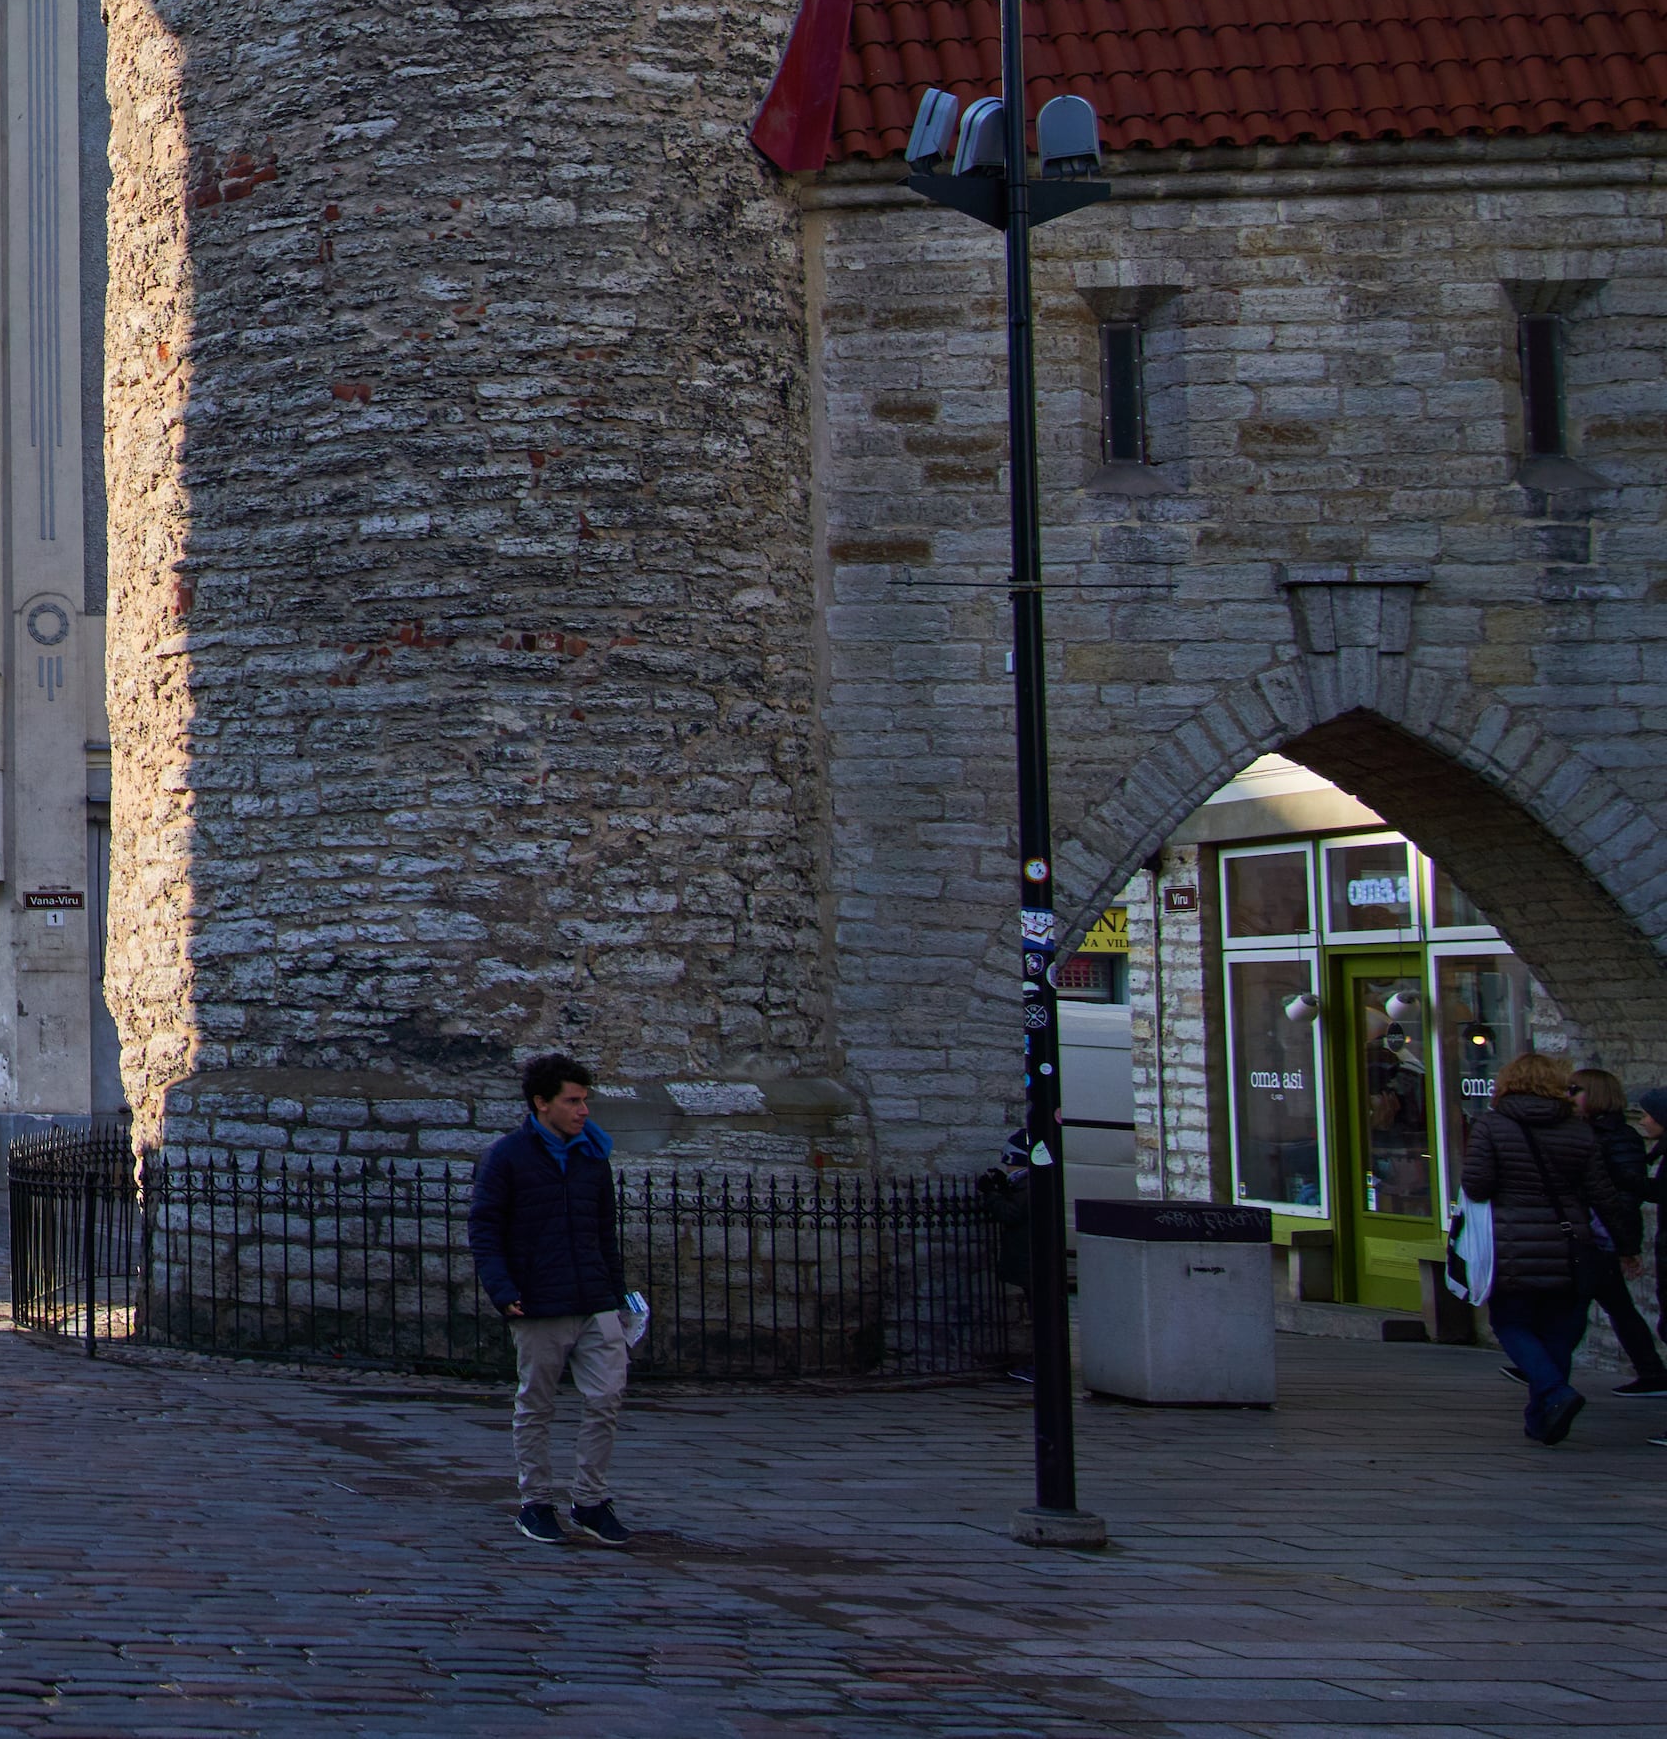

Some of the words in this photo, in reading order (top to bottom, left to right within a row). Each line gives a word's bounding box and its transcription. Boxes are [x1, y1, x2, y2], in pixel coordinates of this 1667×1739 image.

[1172, 893, 1188, 905] Viru
[1348, 878, 1396, 906] oma
[29, 896, 79, 905] Vana-Viru
[52, 913, 57, 923] 1
[1251, 1071, 1280, 1088] oma
[1282, 1068, 1304, 1089] asi
[1461, 1076, 1495, 1097] oma
